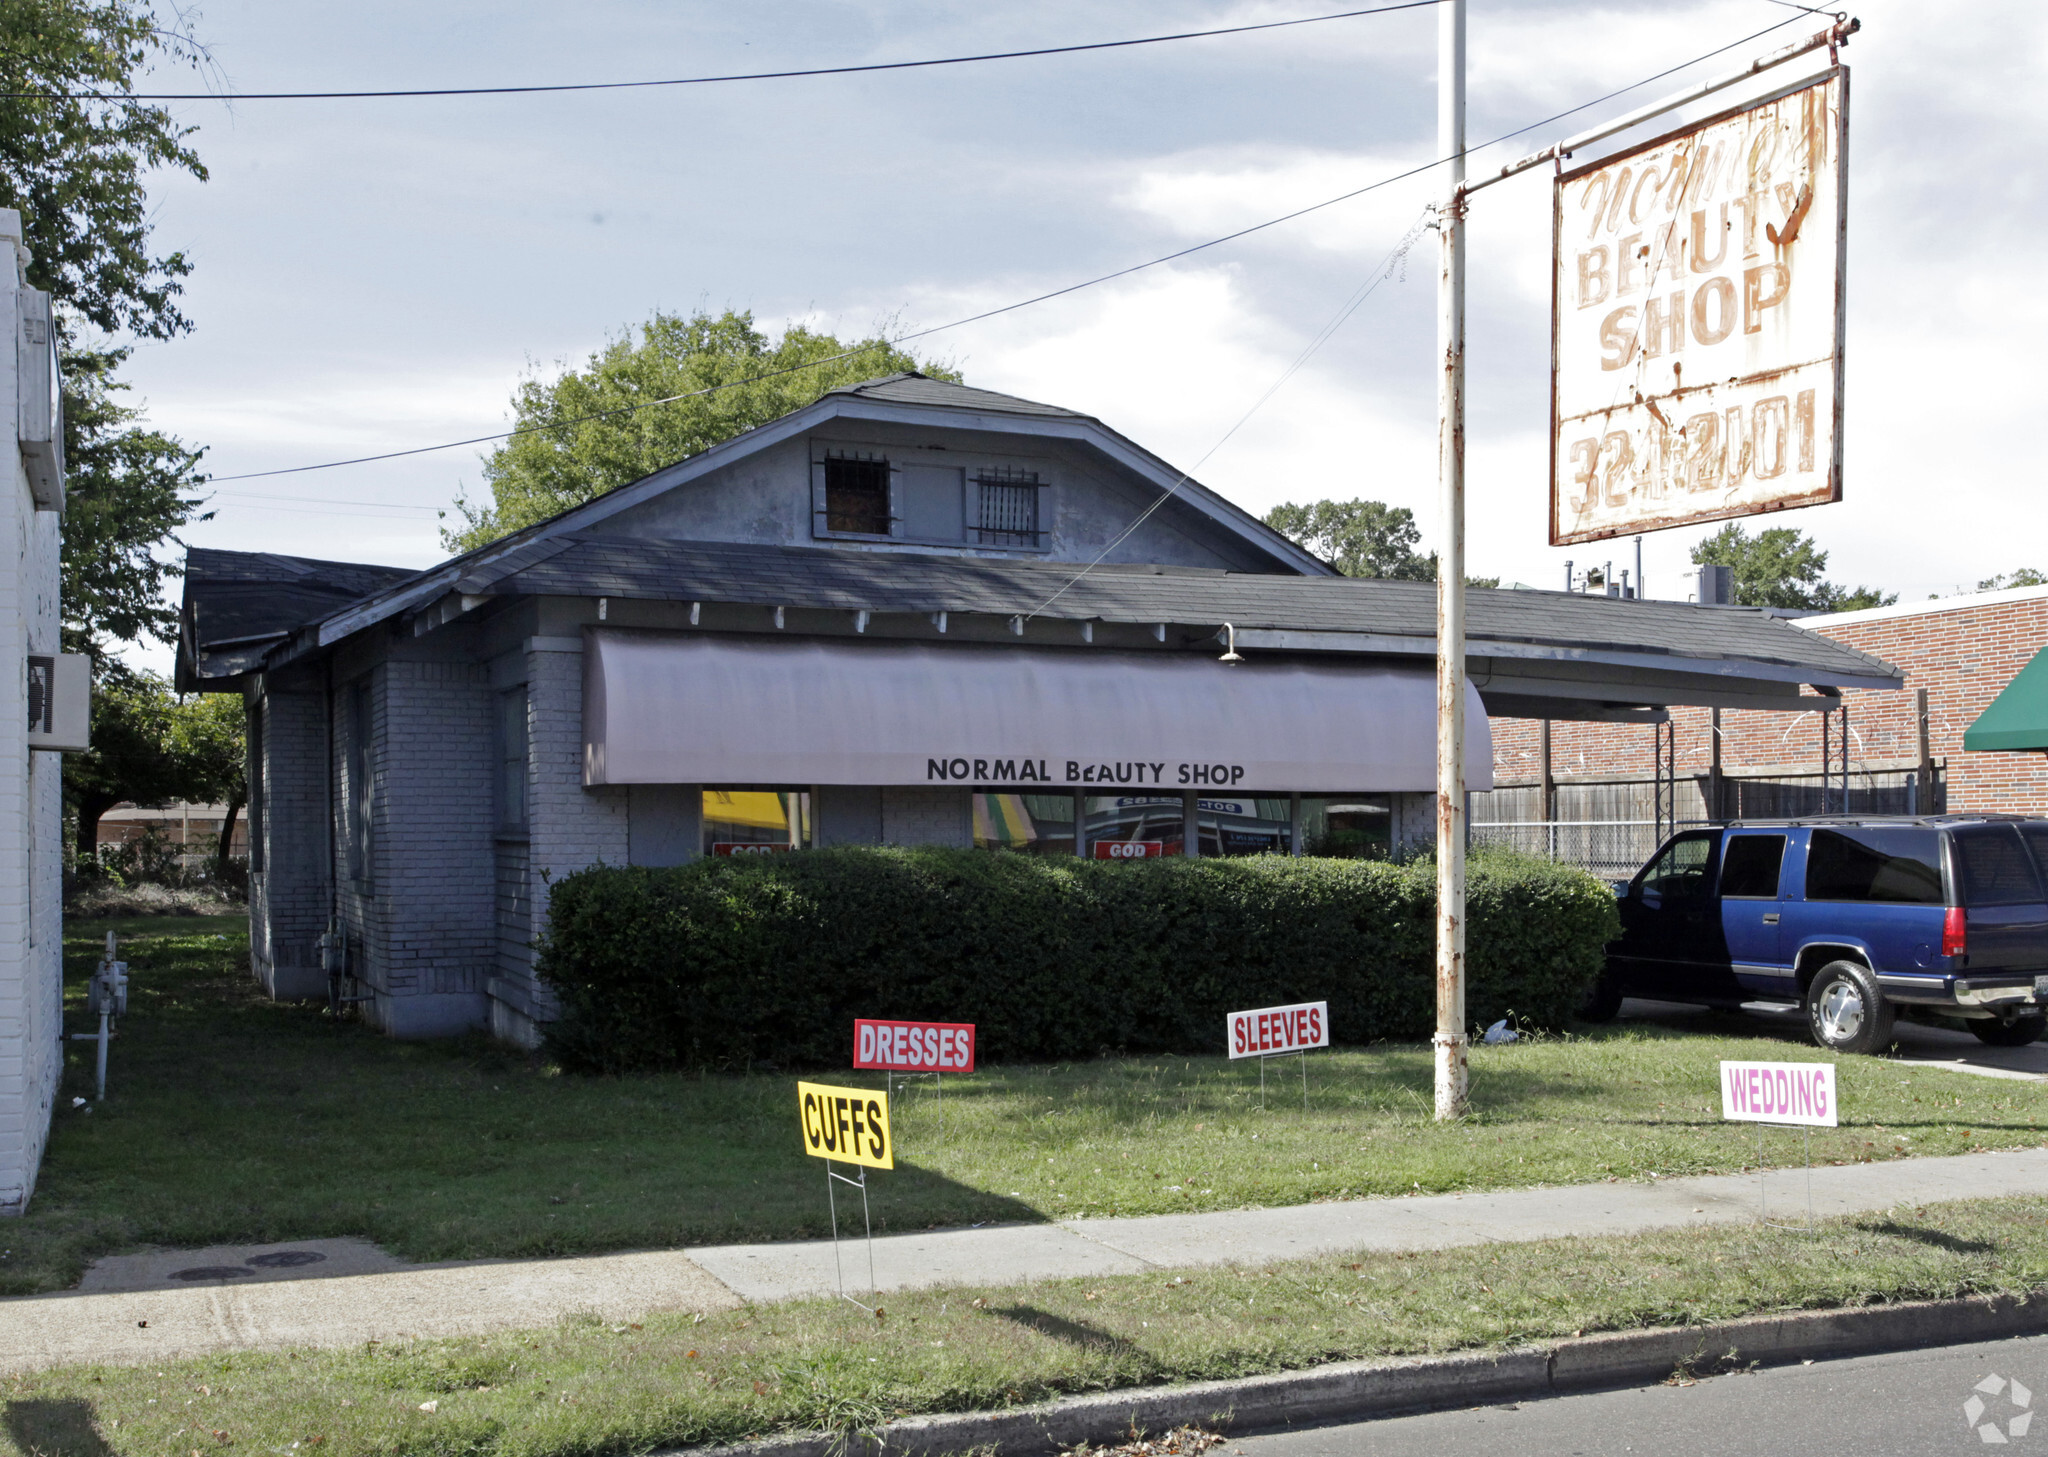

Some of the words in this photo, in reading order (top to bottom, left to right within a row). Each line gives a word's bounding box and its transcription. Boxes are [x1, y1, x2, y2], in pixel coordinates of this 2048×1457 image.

[1577, 182, 1814, 311] BEAUTY
[1600, 262, 1791, 371] SHOP
[927, 758, 1052, 782] NORMAL
[1065, 760, 1166, 784] BEAUTY
[1177, 763, 1245, 786] SHOP
[1109, 843, 1146, 858] GOD
[859, 1024, 969, 1068] DRESSES
[1235, 1007, 1322, 1054] SLEEVES
[1728, 1068, 1827, 1118] WEDDING
[804, 1092, 885, 1160] CUFFS
